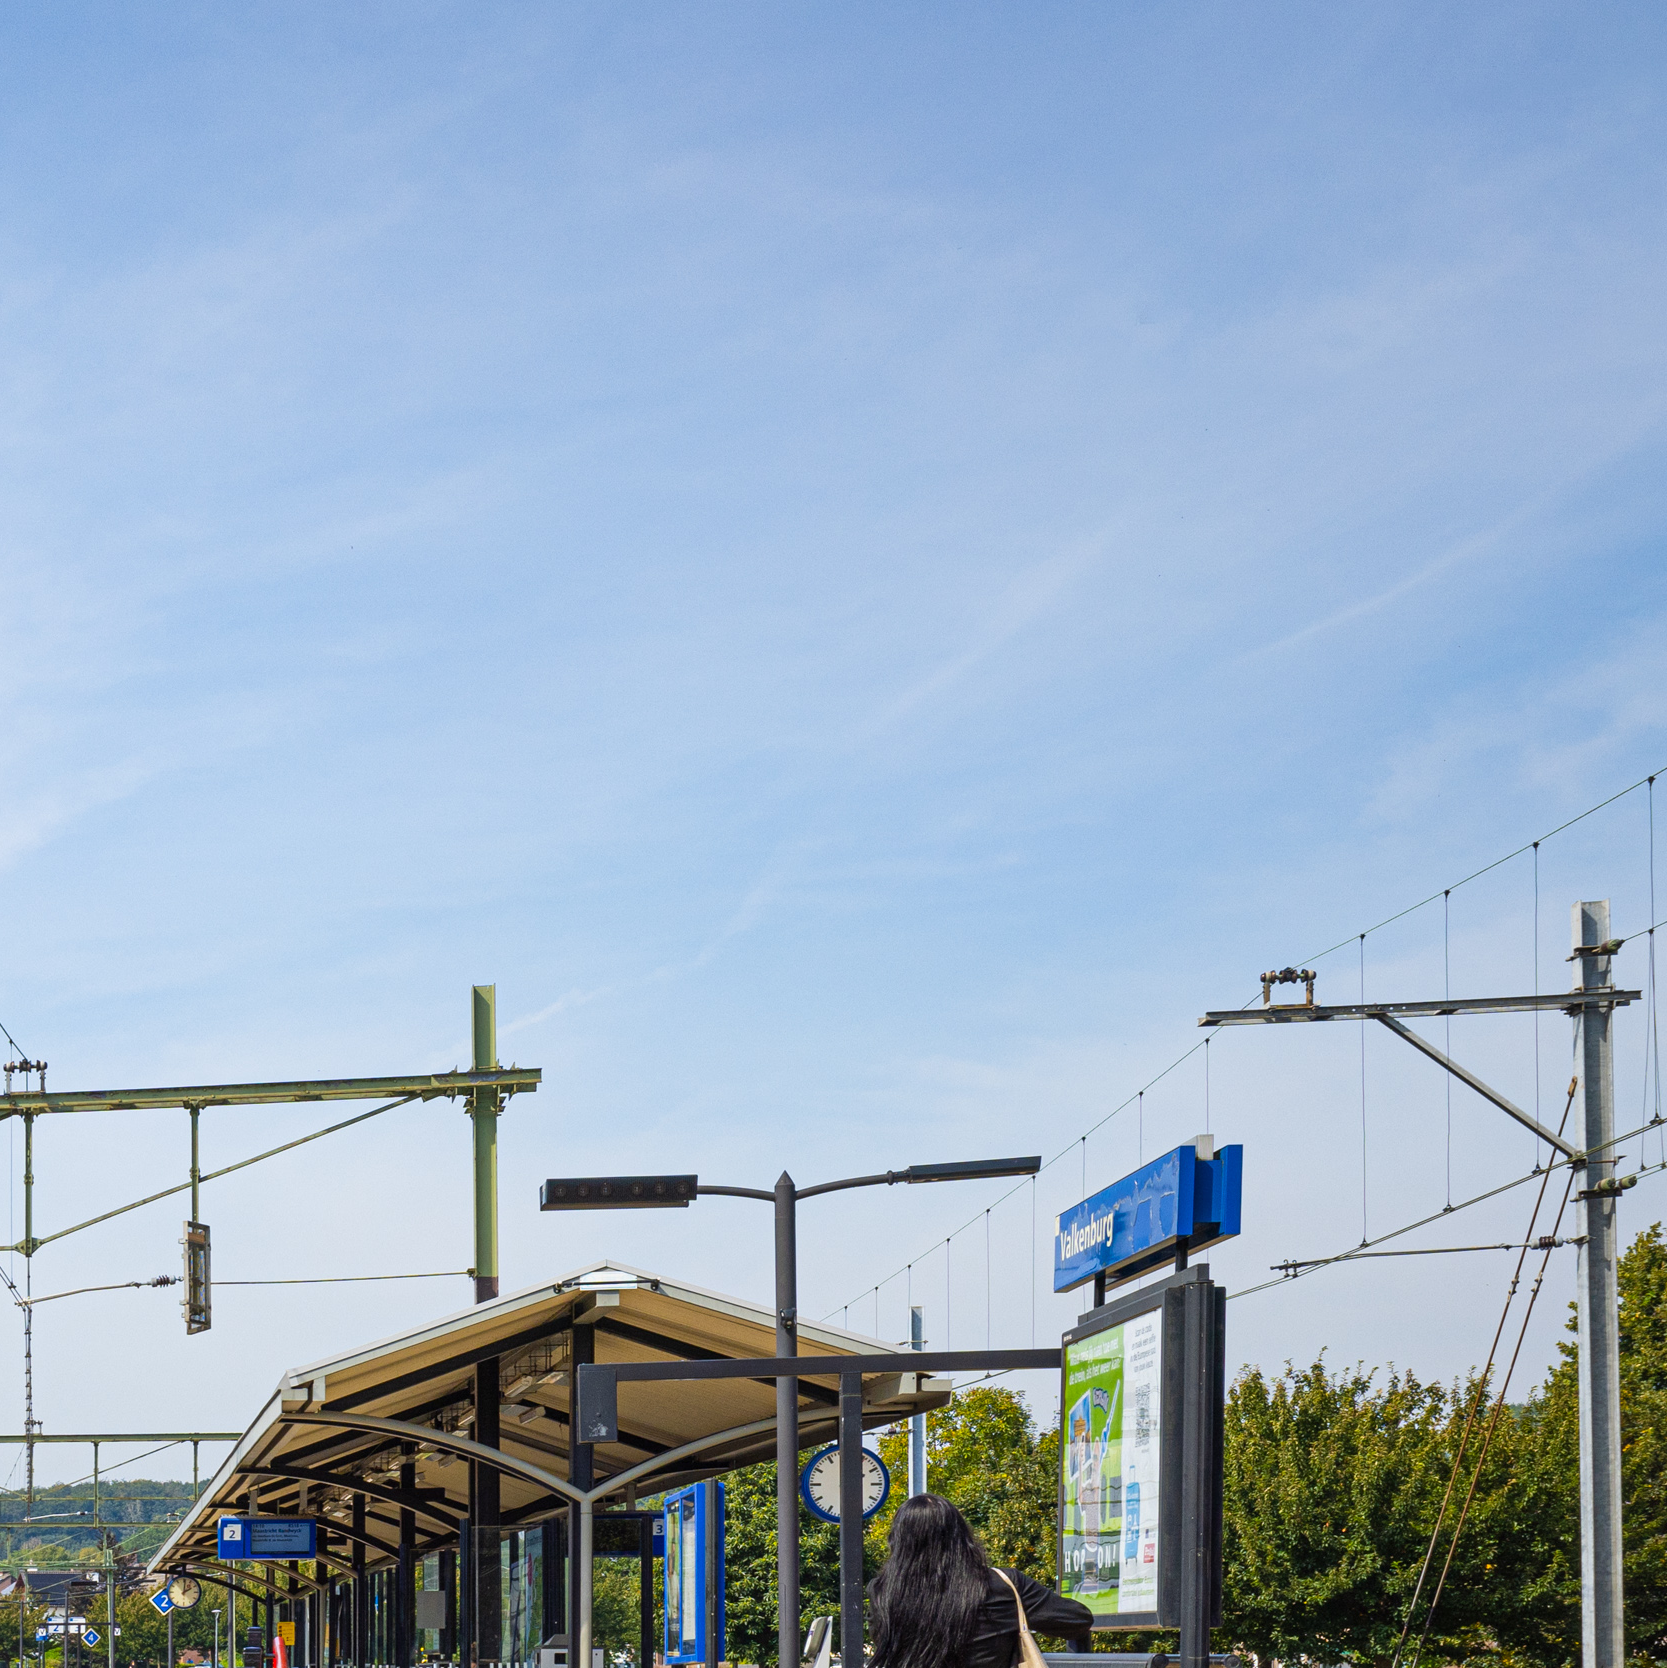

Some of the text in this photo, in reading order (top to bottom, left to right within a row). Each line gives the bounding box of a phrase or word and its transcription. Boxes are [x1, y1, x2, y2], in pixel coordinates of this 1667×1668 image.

[1060, 1212, 1114, 1262] Valkenburg
[228, 1529, 236, 1539] 2
[655, 1524, 663, 1534] 3
[160, 1595, 169, 1608] 2
[88, 1633, 94, 1641] 4
